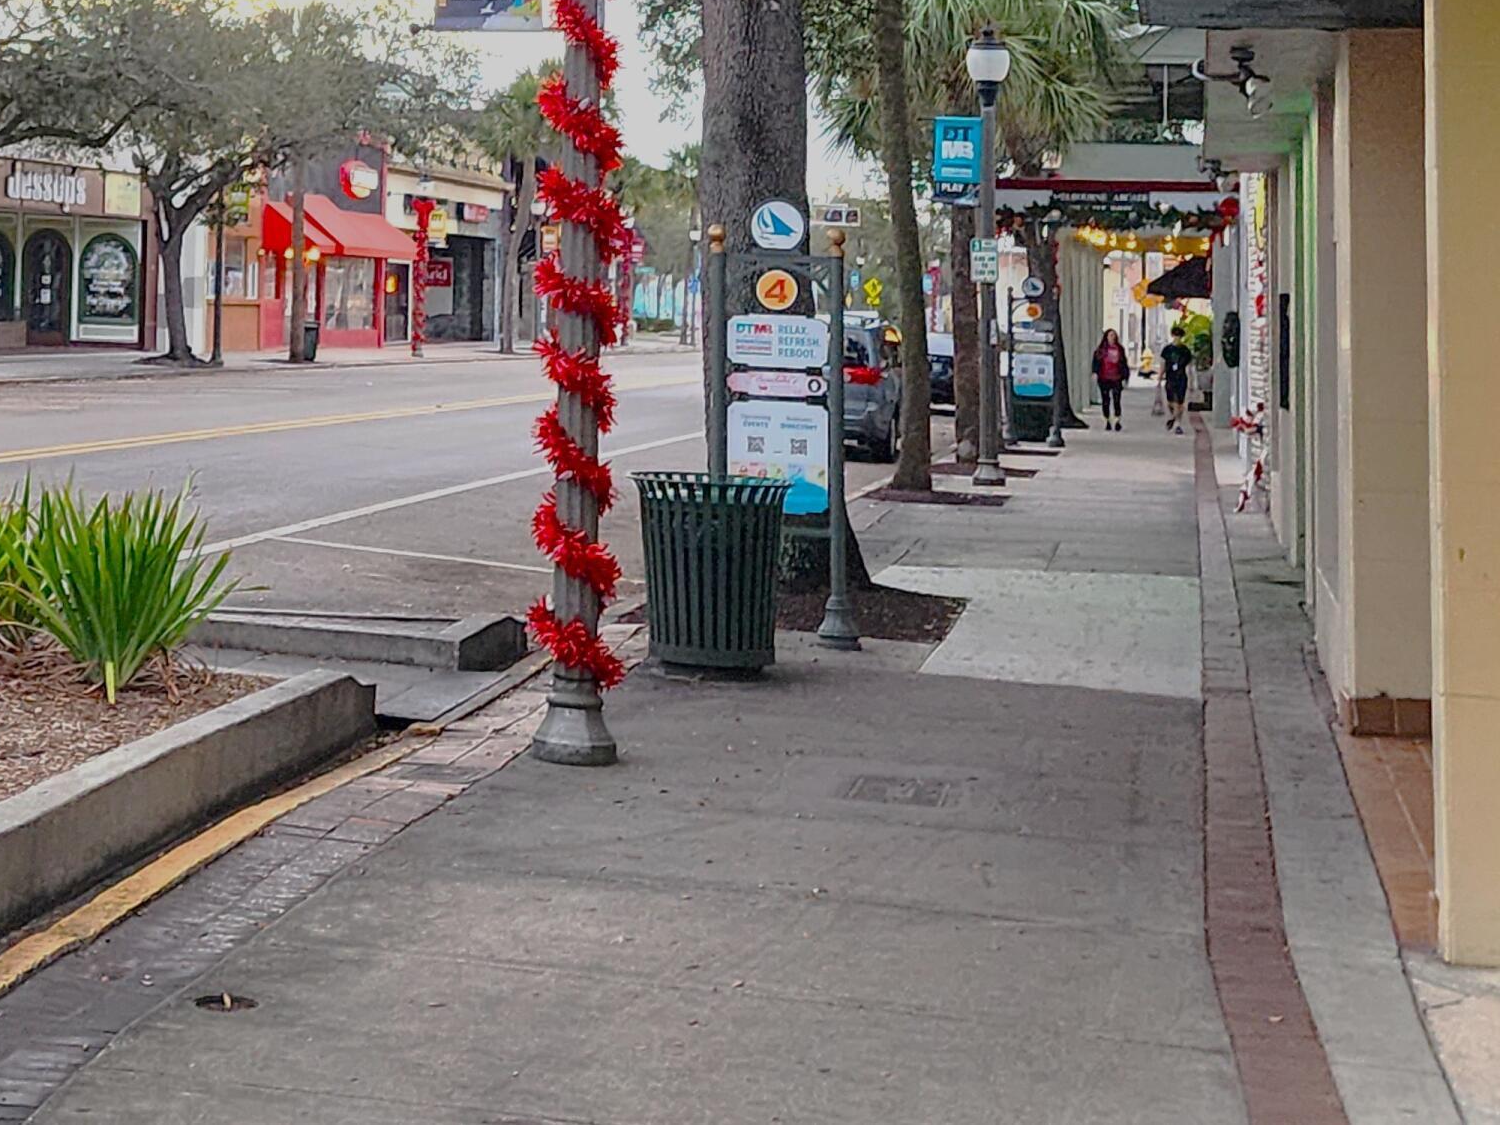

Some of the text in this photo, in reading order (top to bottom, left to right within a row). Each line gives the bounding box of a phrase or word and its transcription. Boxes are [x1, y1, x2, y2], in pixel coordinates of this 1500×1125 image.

[6, 162, 87, 214] Jessups
[941, 183, 965, 193] PLAY
[764, 278, 788, 304] 4
